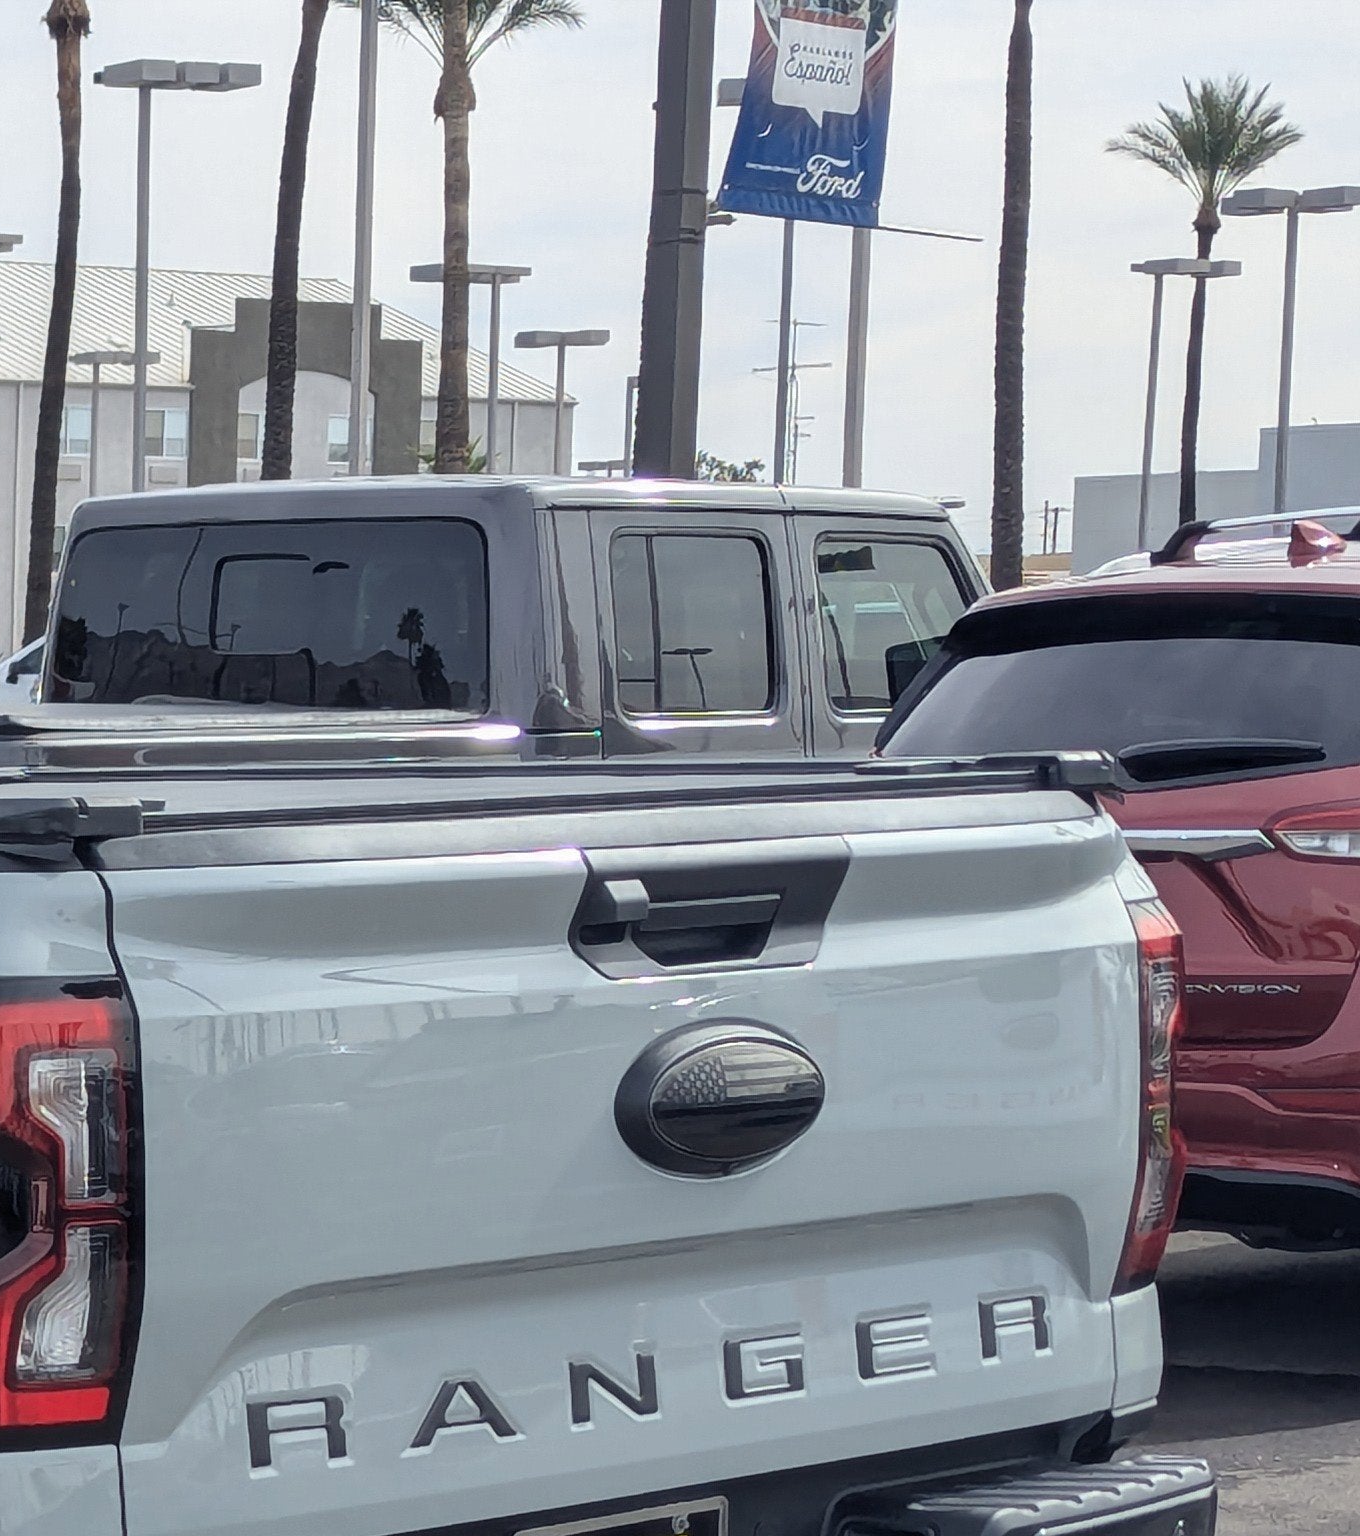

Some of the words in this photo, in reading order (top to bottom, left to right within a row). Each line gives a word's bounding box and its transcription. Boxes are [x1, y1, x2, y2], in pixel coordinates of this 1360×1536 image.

[796, 154, 865, 199] Ford
[1185, 983, 1301, 994] ENVISION
[245, 1293, 1054, 1479] RANGER
